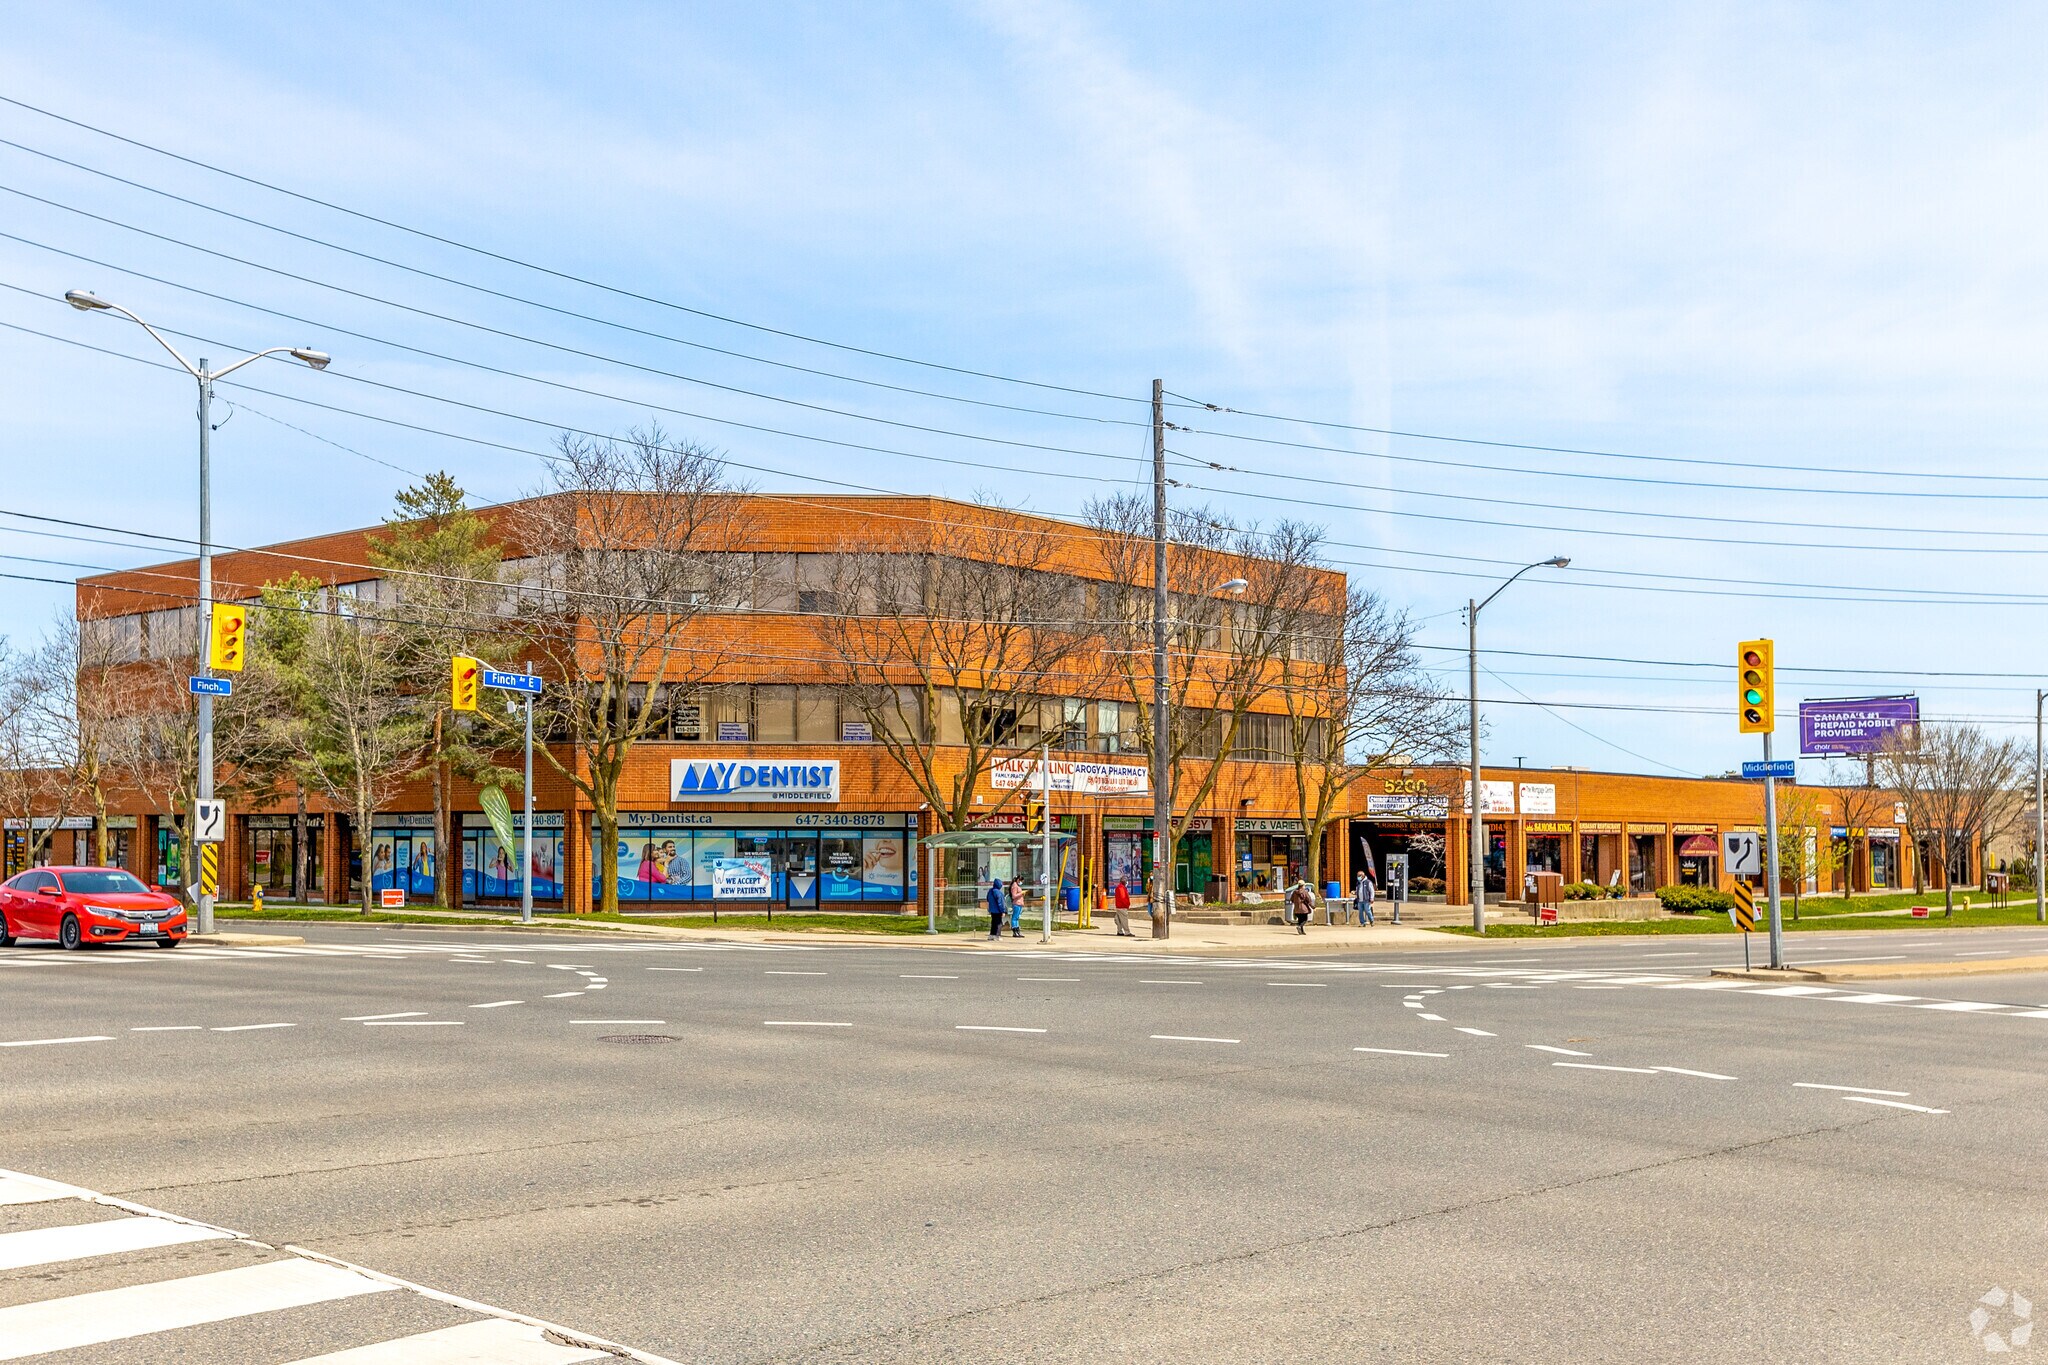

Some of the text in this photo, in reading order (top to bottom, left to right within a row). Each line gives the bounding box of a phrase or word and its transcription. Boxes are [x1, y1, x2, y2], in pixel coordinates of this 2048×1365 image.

[492, 672, 516, 685] Finch
[528, 677, 534, 688] E
[197, 681, 219, 691] Finch
[1814, 712, 1866, 722] CANADA'S
[1814, 719, 1898, 730] PREPAID MOBILE
[1814, 728, 1867, 737] PROVIDER.
[994, 759, 1039, 773] WALK-IN
[1076, 764, 1147, 777] AROGYA PHARMACY
[1744, 762, 1794, 772] Middlefield
[740, 765, 834, 788] DENTIST
[628, 812, 713, 826] My-Dentist.ca
[795, 814, 885, 827] 647-340-8878
[1270, 821, 1302, 830] VARIET
[1558, 823, 1572, 832] KING
[725, 877, 737, 885] WE
[721, 887, 736, 895] NEW
